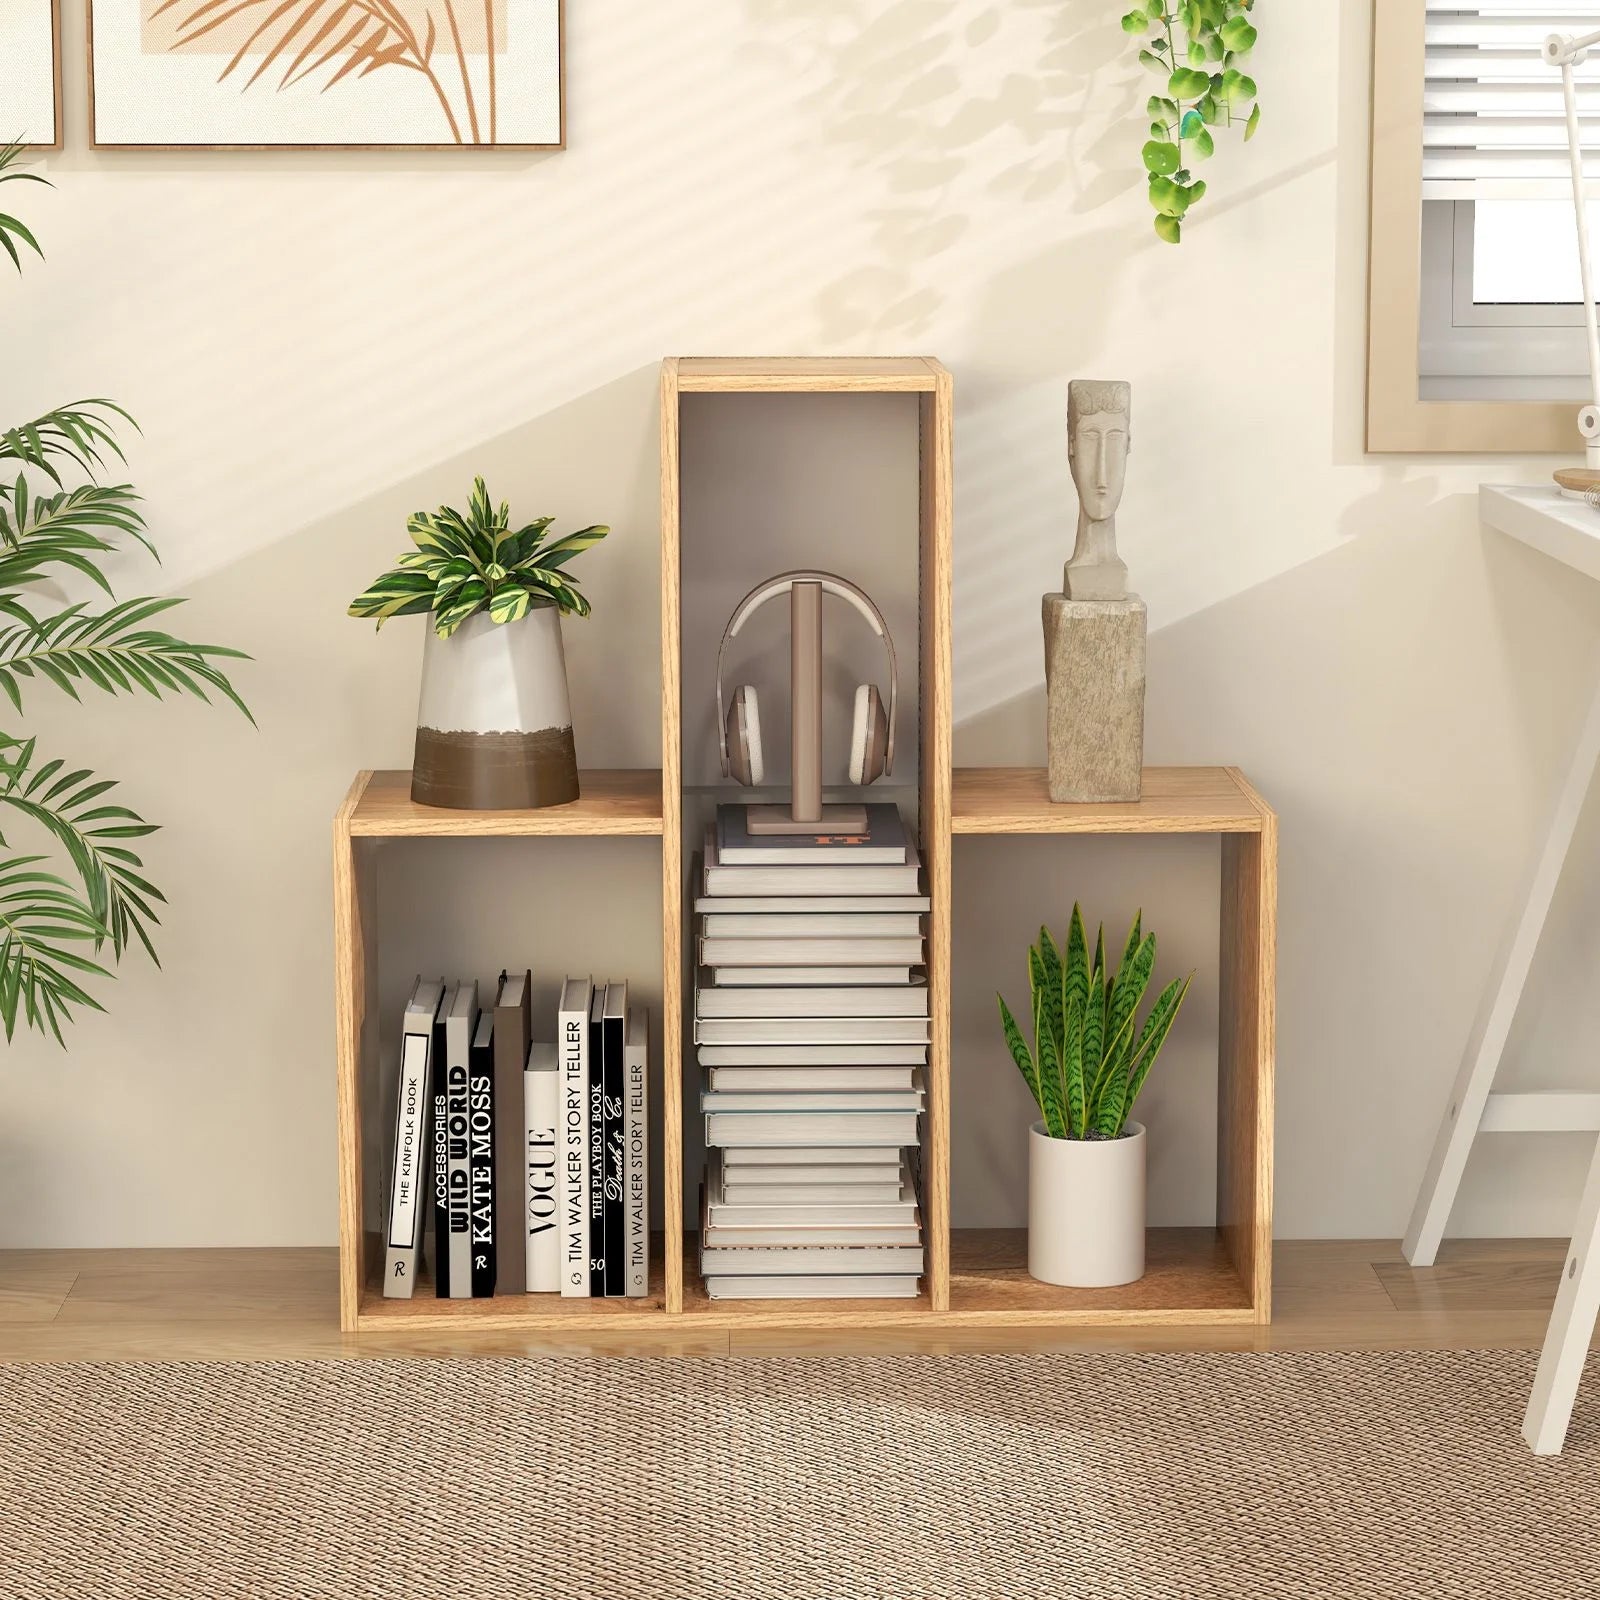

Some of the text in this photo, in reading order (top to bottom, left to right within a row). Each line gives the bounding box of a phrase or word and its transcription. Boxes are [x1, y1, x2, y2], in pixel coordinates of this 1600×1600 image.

[399, 1078, 418, 1207] THE KINFOLK BOOK
[435, 1095, 447, 1209] ACCESSORIES
[449, 1065, 470, 1233] WILD WORLD
[470, 1076, 492, 1245] KATE MOSS
[566, 1021, 582, 1263] TIM WALKER STORY TELLER
[591, 1083, 603, 1219] THE PLAYBOY BOOK
[604, 1095, 623, 1120] Co
[630, 1065, 644, 1267] TIM WALKER STORY TELLER
[528, 1128, 557, 1238] VOGUE
[604, 1142, 623, 1202] Death
[394, 1261, 406, 1277] R
[475, 1255, 488, 1270] R
